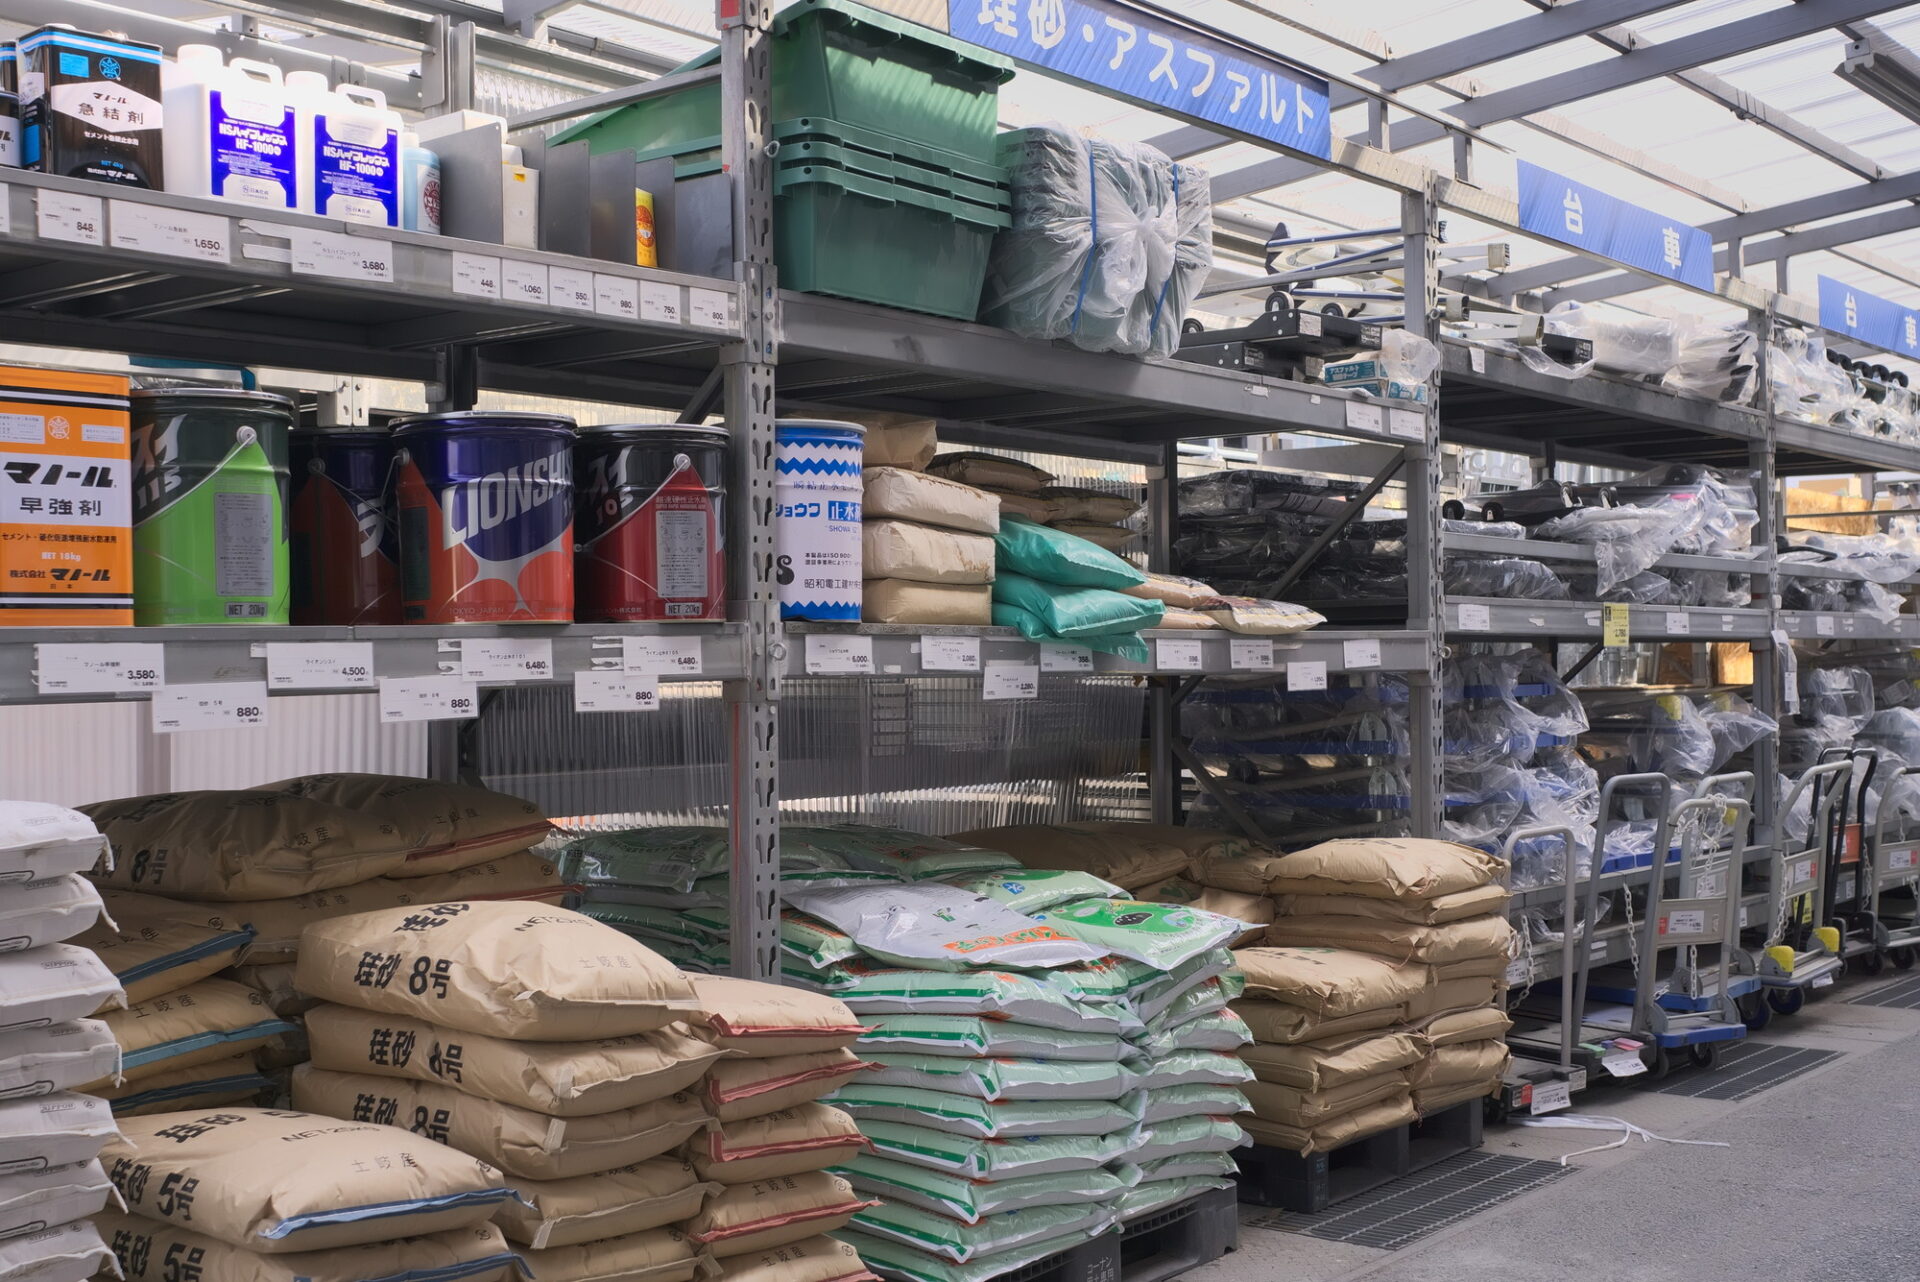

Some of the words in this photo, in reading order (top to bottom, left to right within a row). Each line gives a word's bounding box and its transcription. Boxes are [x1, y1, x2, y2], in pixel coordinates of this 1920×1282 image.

[78, 102, 144, 125] 急結剤
[77, 221, 94, 233] 848
[194, 238, 220, 251] 1,650
[361, 260, 385, 271] 3,680
[3, 461, 113, 488] マノール
[19, 497, 102, 517] 早強剤
[9, 568, 46, 579] 株式会社
[50, 568, 110, 581] マノール
[228, 604, 243, 616] NET
[247, 604, 266, 617] 20kg
[668, 604, 681, 615] NET
[684, 604, 701, 616] 20kg
[342, 666, 366, 676] 4,500
[525, 661, 546, 670] 6,480
[127, 669, 156, 680] 3,580
[635, 691, 652, 700] 880
[450, 698, 470, 708] 880
[236, 706, 259, 718] 880
[409, 955, 453, 1000] 8号
[156, 1172, 200, 1221] 5号
